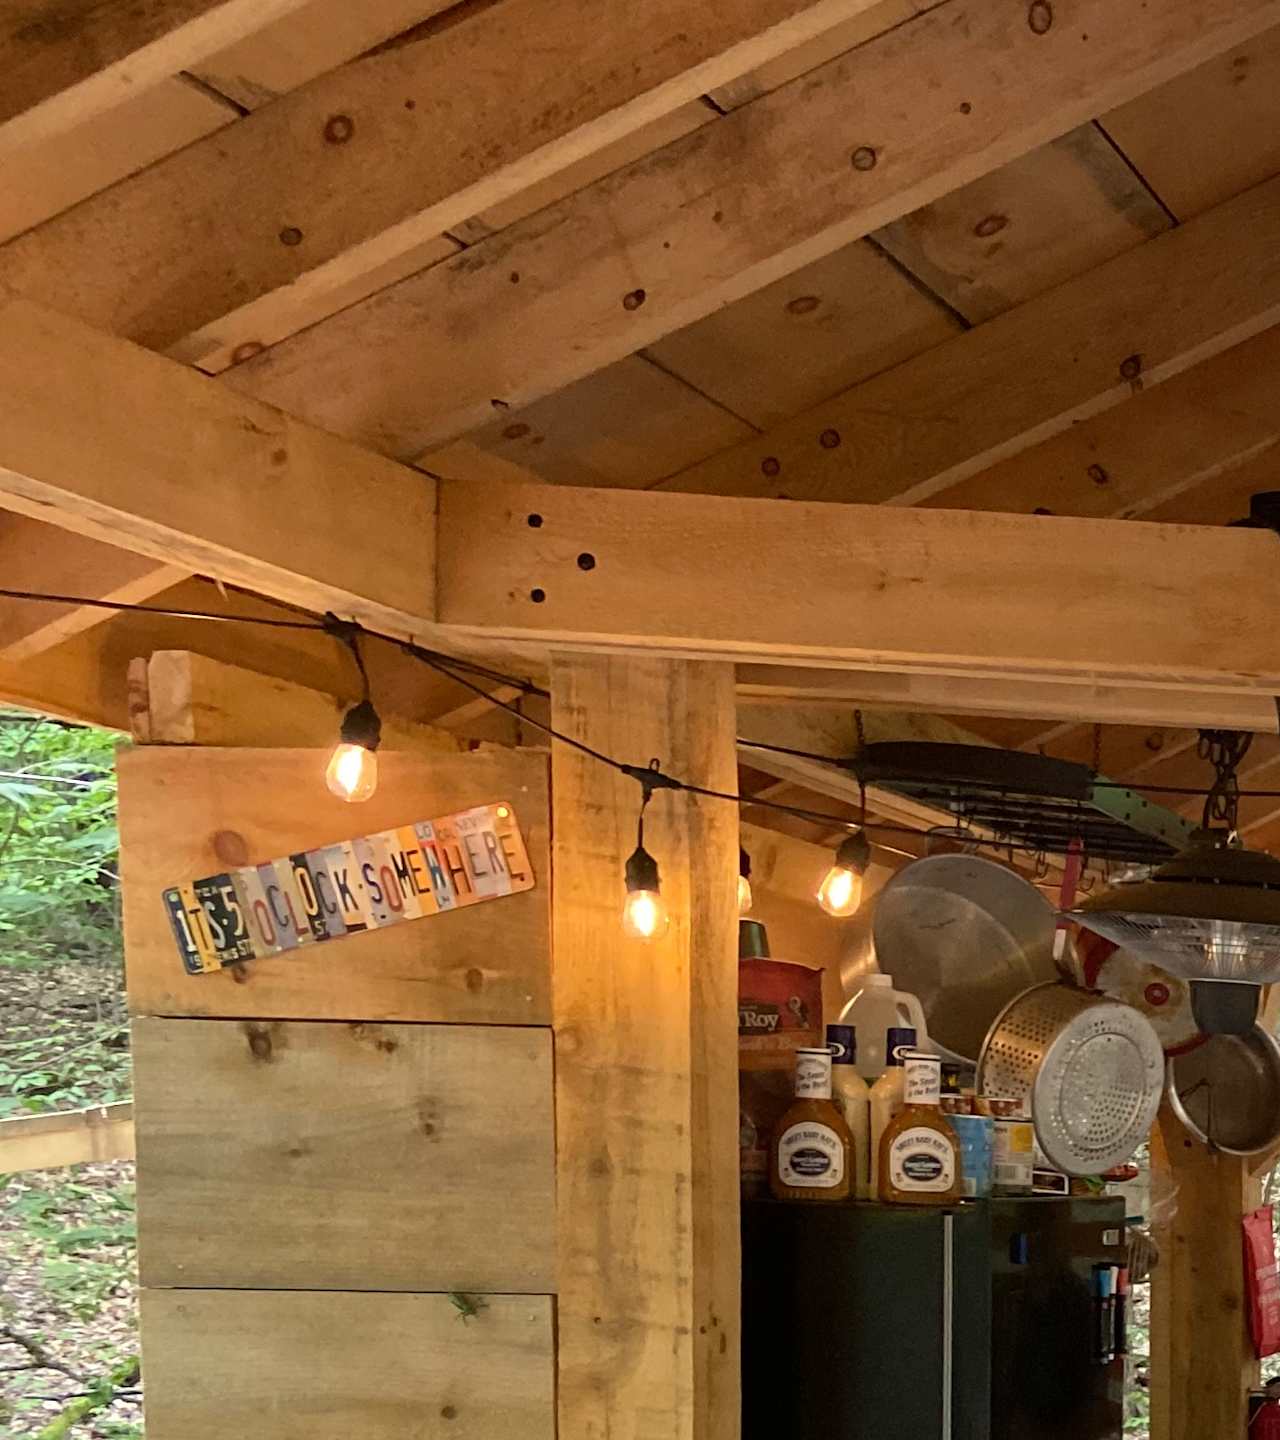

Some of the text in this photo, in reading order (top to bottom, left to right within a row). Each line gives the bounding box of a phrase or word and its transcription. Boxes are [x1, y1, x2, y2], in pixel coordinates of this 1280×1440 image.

[219, 885, 245, 937] 5
[361, 830, 524, 912] SOMEWHERE
[743, 1010, 780, 1032] Roy
